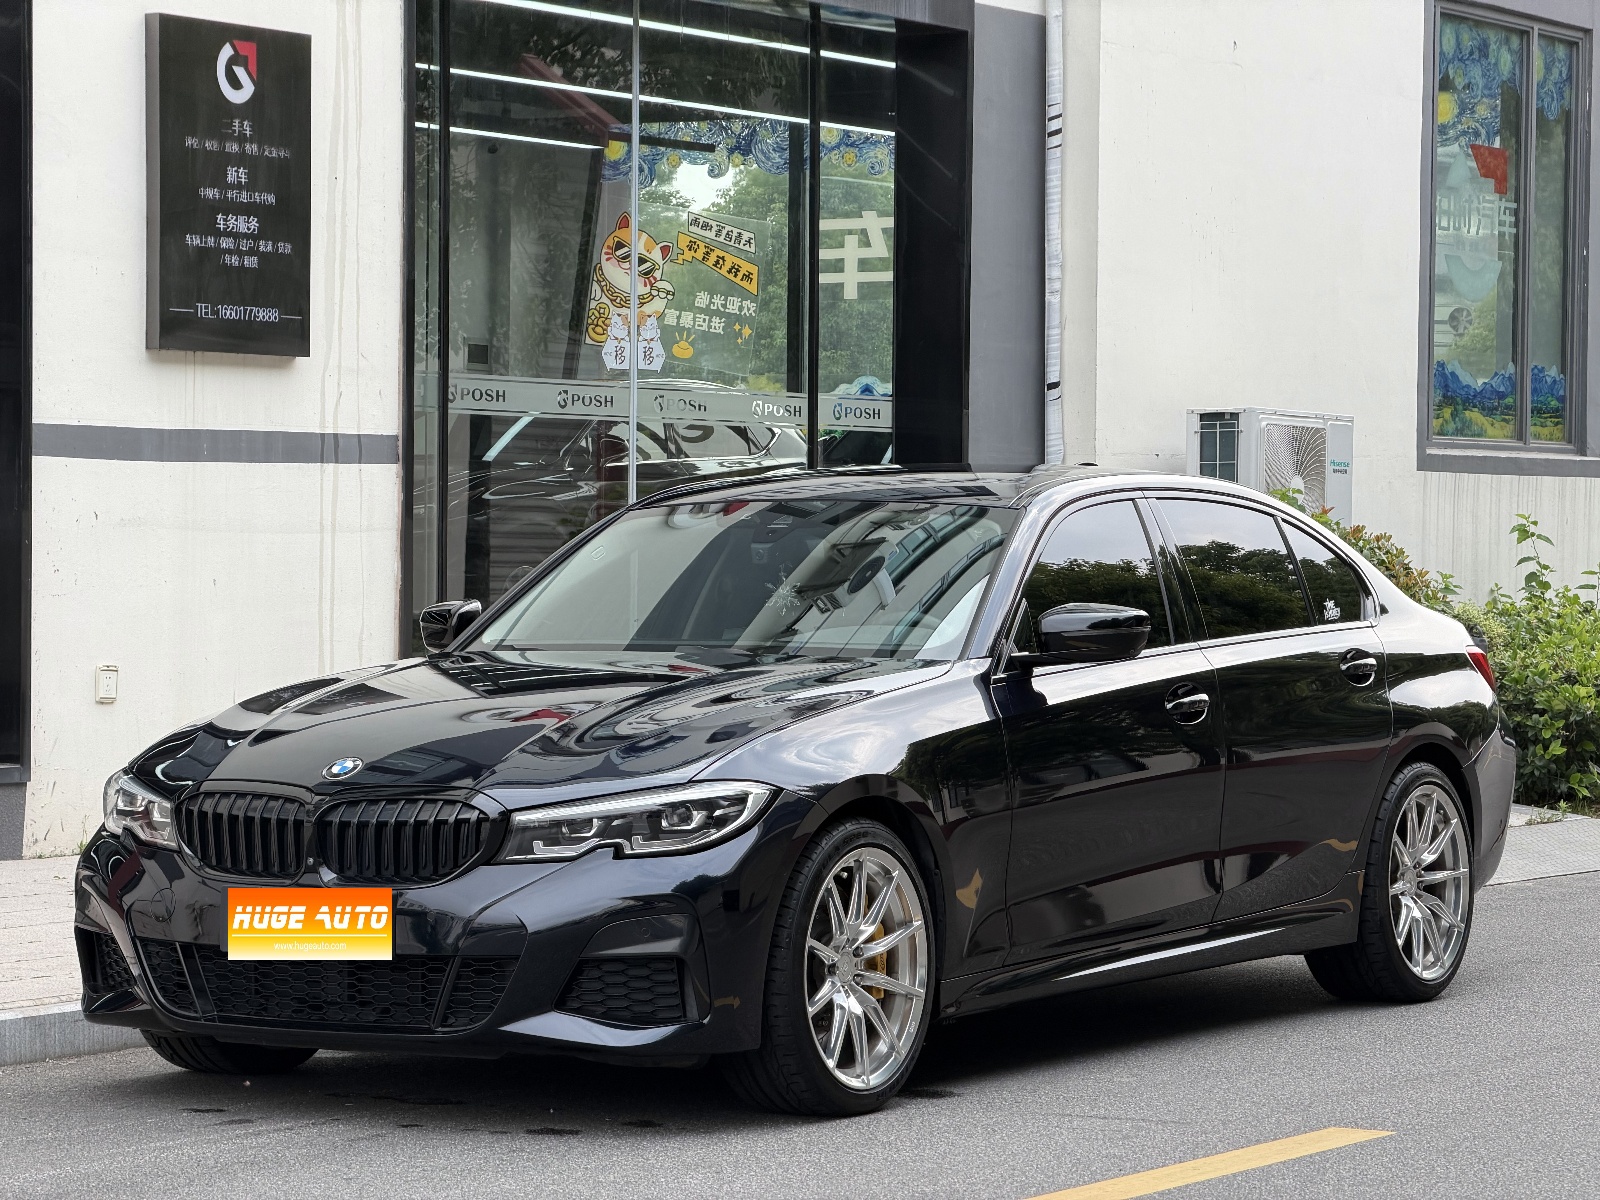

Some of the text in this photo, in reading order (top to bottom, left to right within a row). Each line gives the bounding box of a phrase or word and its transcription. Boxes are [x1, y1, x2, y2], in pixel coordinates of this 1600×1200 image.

[221, 119, 253, 137] 二手车
[226, 165, 249, 185] 新车
[216, 213, 260, 234] 车务服务
[460, 387, 506, 403] POSH
[571, 393, 614, 408] POSH
[764, 403, 802, 418] POSH
[845, 406, 881, 420] POSH
[1329, 459, 1350, 468] Hisense
